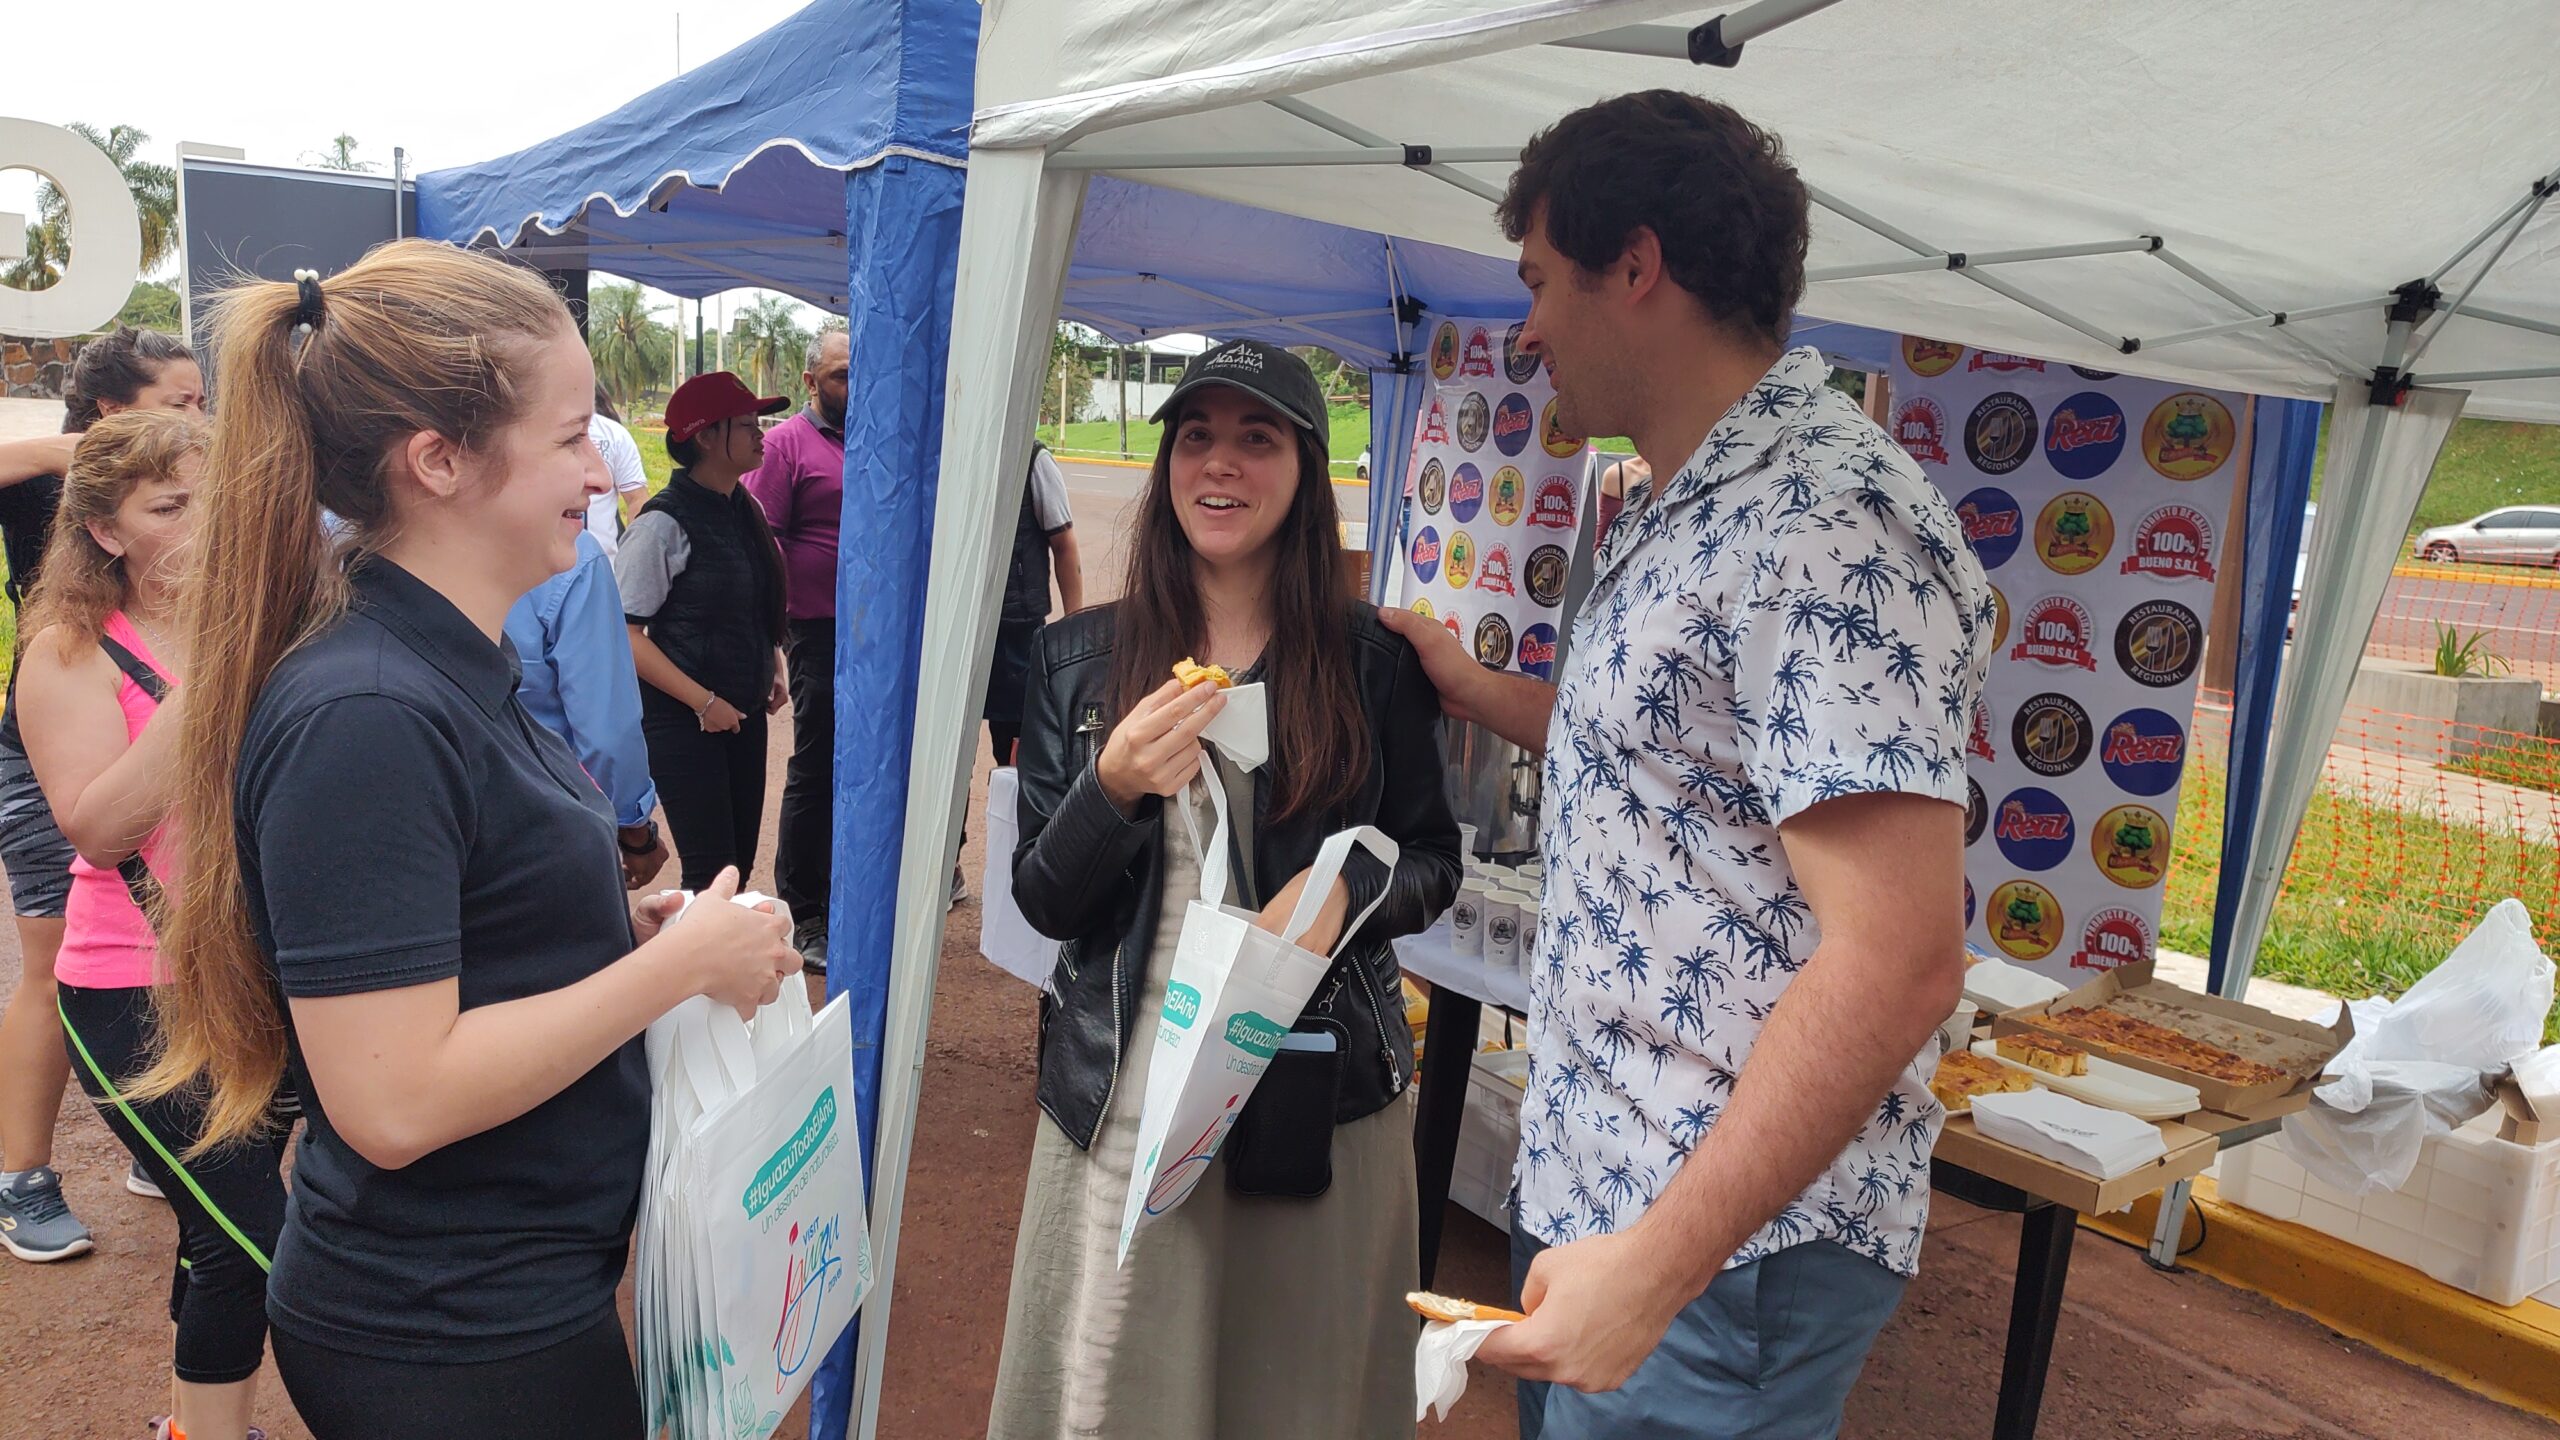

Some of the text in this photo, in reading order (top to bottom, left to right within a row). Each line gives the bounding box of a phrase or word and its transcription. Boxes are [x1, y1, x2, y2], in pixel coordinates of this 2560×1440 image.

[1226, 344, 1263, 360] ALA
[1976, 396, 2031, 418] RESTAURANTE
[1495, 408, 1531, 437] Real
[1902, 421, 1932, 440] 100%
[2048, 413, 2122, 452] Real
[1976, 456, 2020, 471] REGIONAL
[1450, 478, 1483, 504] Real
[1542, 494, 1569, 511] 100%
[2137, 506, 2211, 549] PRODUCTO DE CALIDAD
[1413, 540, 1440, 566] Real
[2152, 531, 2196, 554] 100%
[1531, 548, 1568, 566] RESTAURANTE
[2138, 556, 2173, 568] BUENO
[2025, 598, 2061, 628] PRODUCTO
[2072, 604, 2090, 640] CALIDAD
[2128, 604, 2197, 631] RESTAURANTE
[2037, 620, 2077, 644] 100%
[2026, 644, 2056, 657] BUENO
[2130, 665, 2185, 683] REGIONAL
[2023, 697, 2084, 724] RESTAURANTE
[2103, 731, 2183, 766] Real
[2025, 754, 2075, 773] REGIONAL
[1997, 806, 2070, 842] Real
[2085, 909, 2124, 937] PRODUCTO
[2099, 931, 2140, 960] 100%
[2087, 953, 2119, 968] BUENO
[749, 1097, 834, 1213] #IguazúTodoElAño
[761, 1214, 774, 1235] Un
[774, 1183, 799, 1222] destino
[802, 1216, 821, 1246] VISIT
